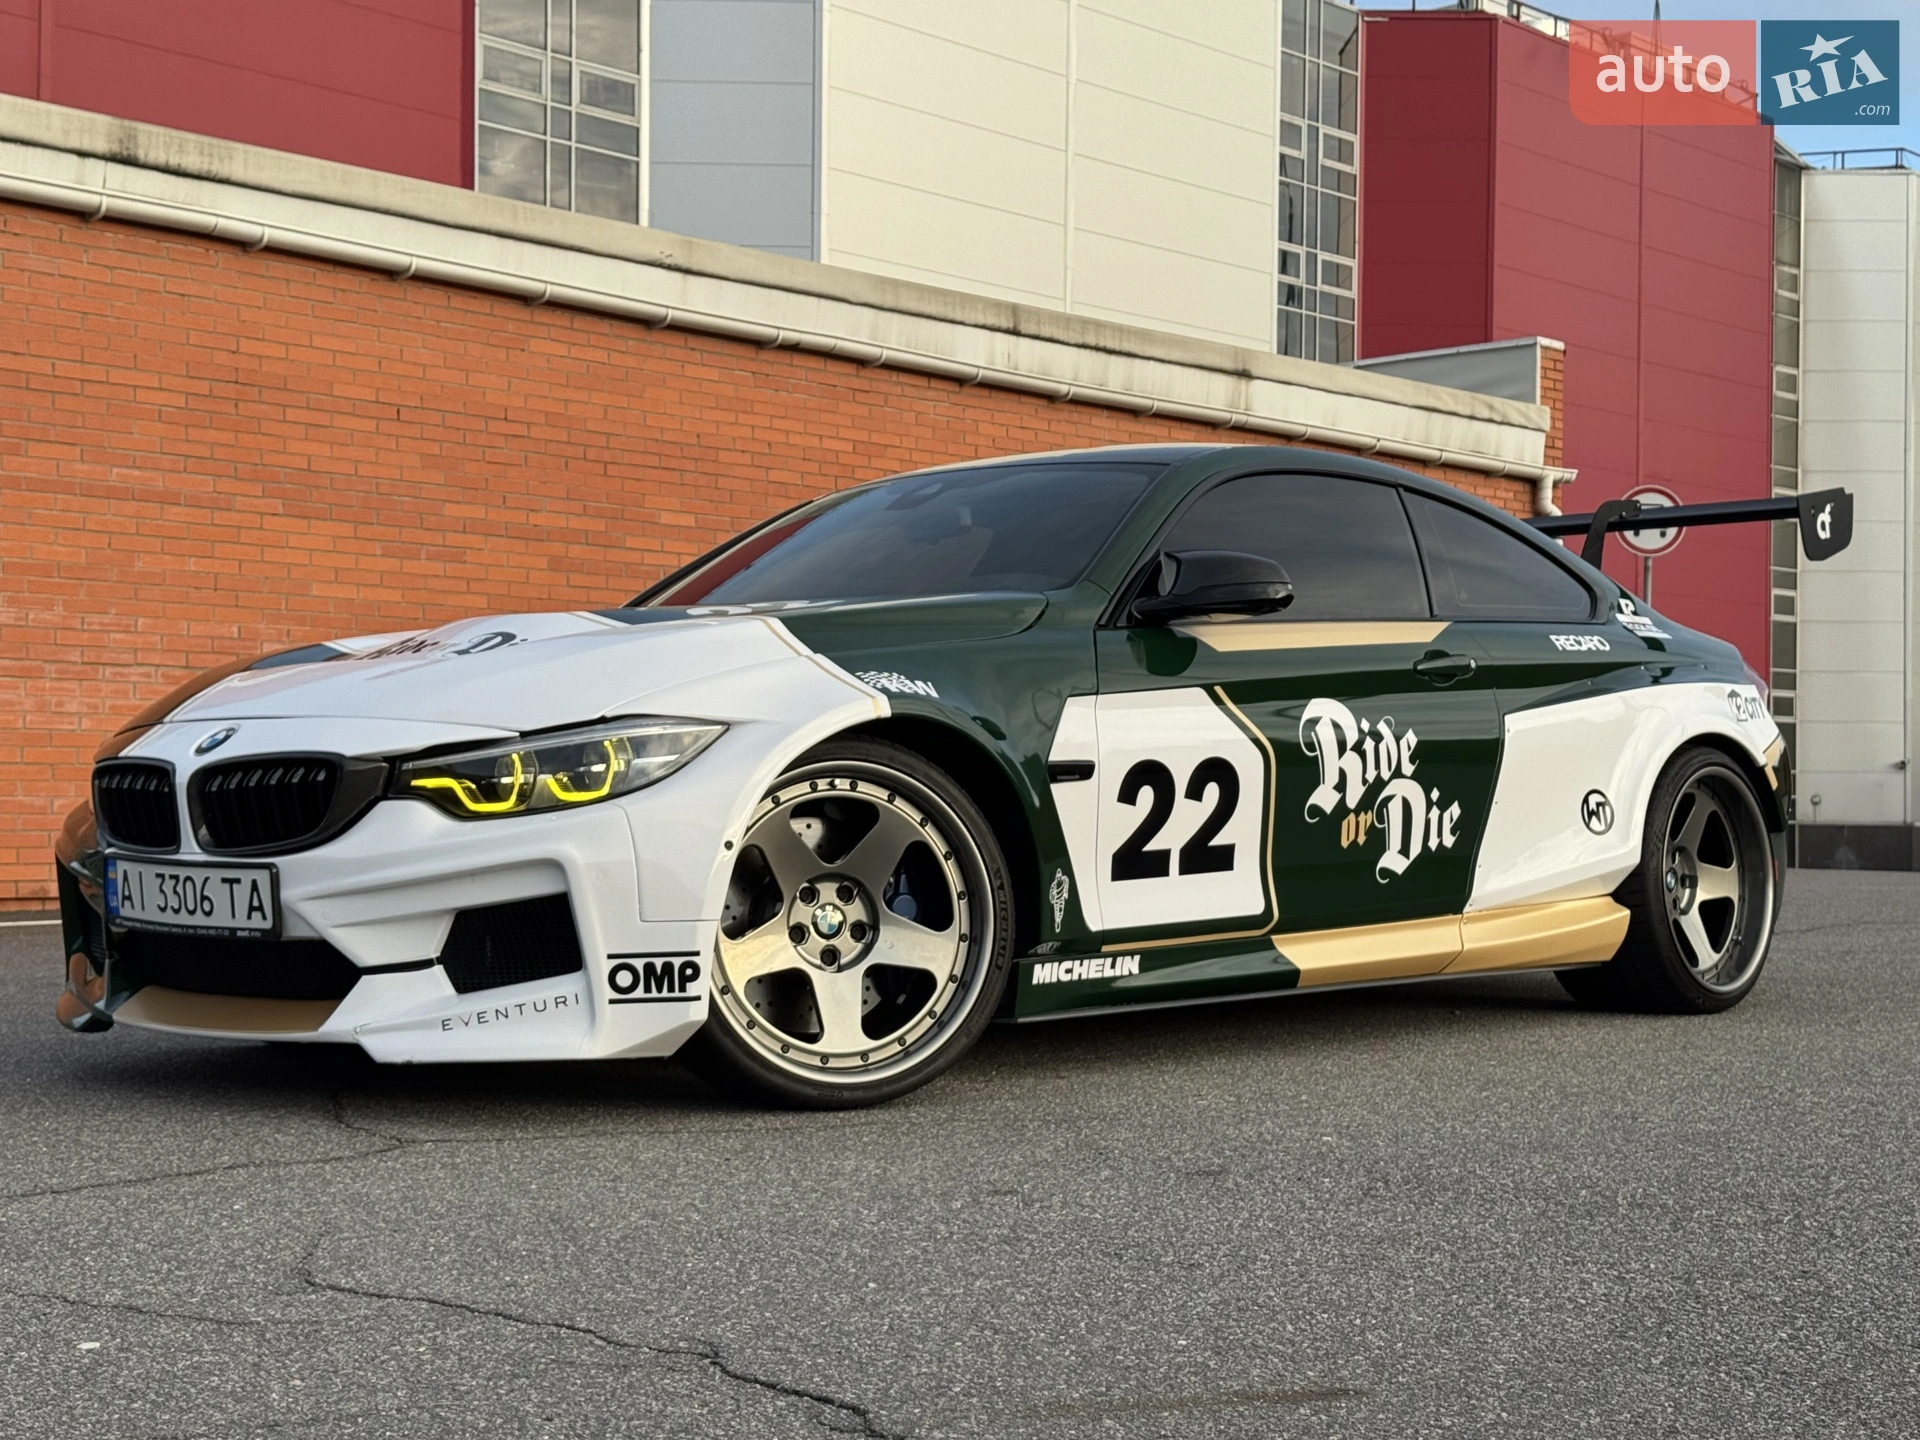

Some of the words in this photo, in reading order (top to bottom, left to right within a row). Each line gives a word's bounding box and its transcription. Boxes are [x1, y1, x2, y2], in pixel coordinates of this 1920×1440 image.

[1549, 635, 1611, 651] RECARO
[1300, 698, 1419, 822] Ride
[1111, 756, 1241, 882] 22
[1341, 810, 1373, 849] or
[1374, 778, 1462, 883] Die
[120, 869, 146, 911] AI
[155, 873, 215, 917] 3306
[221, 876, 268, 921] TA
[608, 960, 701, 995] OMP
[1032, 955, 1141, 985] MICHELIN
[441, 993, 580, 1032] EVENTURI
